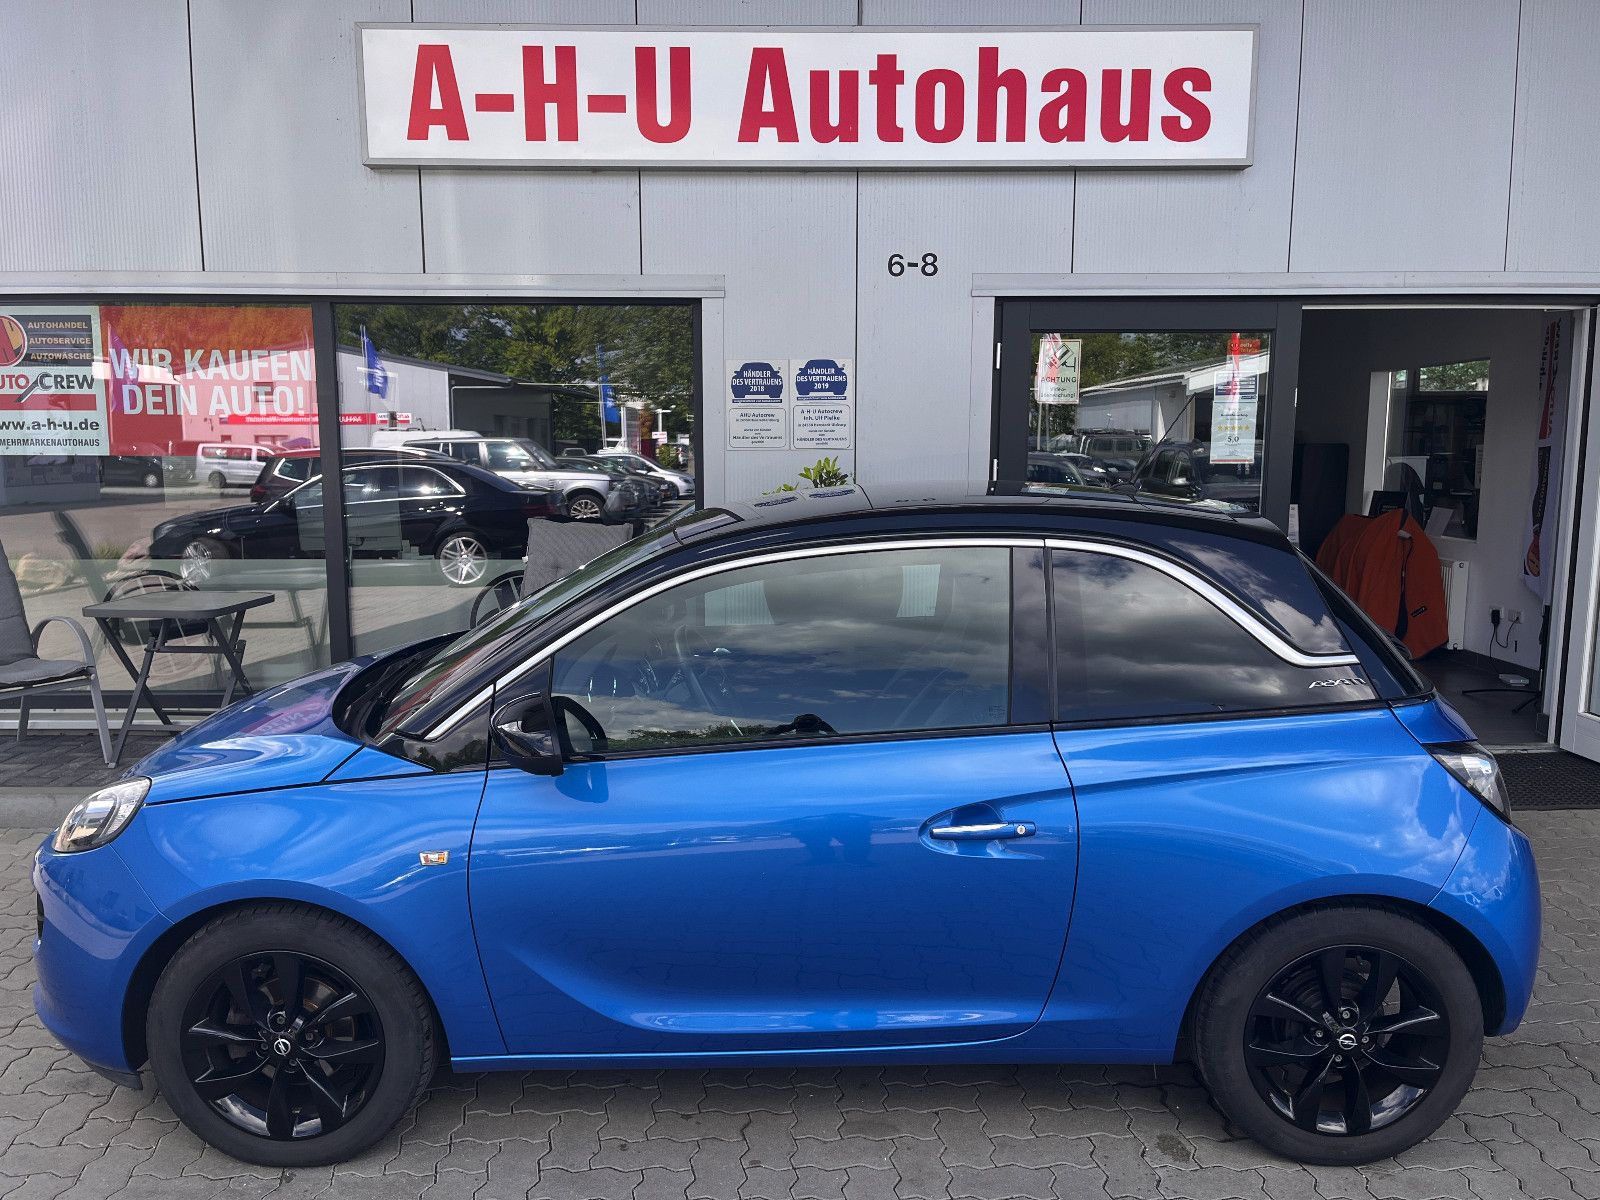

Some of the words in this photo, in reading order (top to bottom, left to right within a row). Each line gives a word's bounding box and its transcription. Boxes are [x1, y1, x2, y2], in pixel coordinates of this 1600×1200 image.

[406, 44, 693, 145] A-H-U
[737, 46, 1213, 145] Autohaus
[887, 253, 939, 277] 6-8
[28, 321, 88, 329] AUTOHANDEL
[29, 337, 92, 345] AUTOSERVICE
[30, 352, 92, 360] AUTOWÄSCHE
[110, 348, 174, 379] WIR
[184, 349, 312, 382] KAUFEN
[743, 369, 771, 378] HÄNDLER
[807, 366, 835, 375] HÄNDLER
[38, 373, 95, 390] CREW
[732, 378, 744, 386] DES
[744, 378, 782, 386] VERTRAUENS
[814, 382, 829, 390] 2019
[122, 384, 198, 416] DEIN
[208, 385, 305, 417] AUTO!
[0, 438, 100, 447] MEHRMARKENAUTOHAUS
